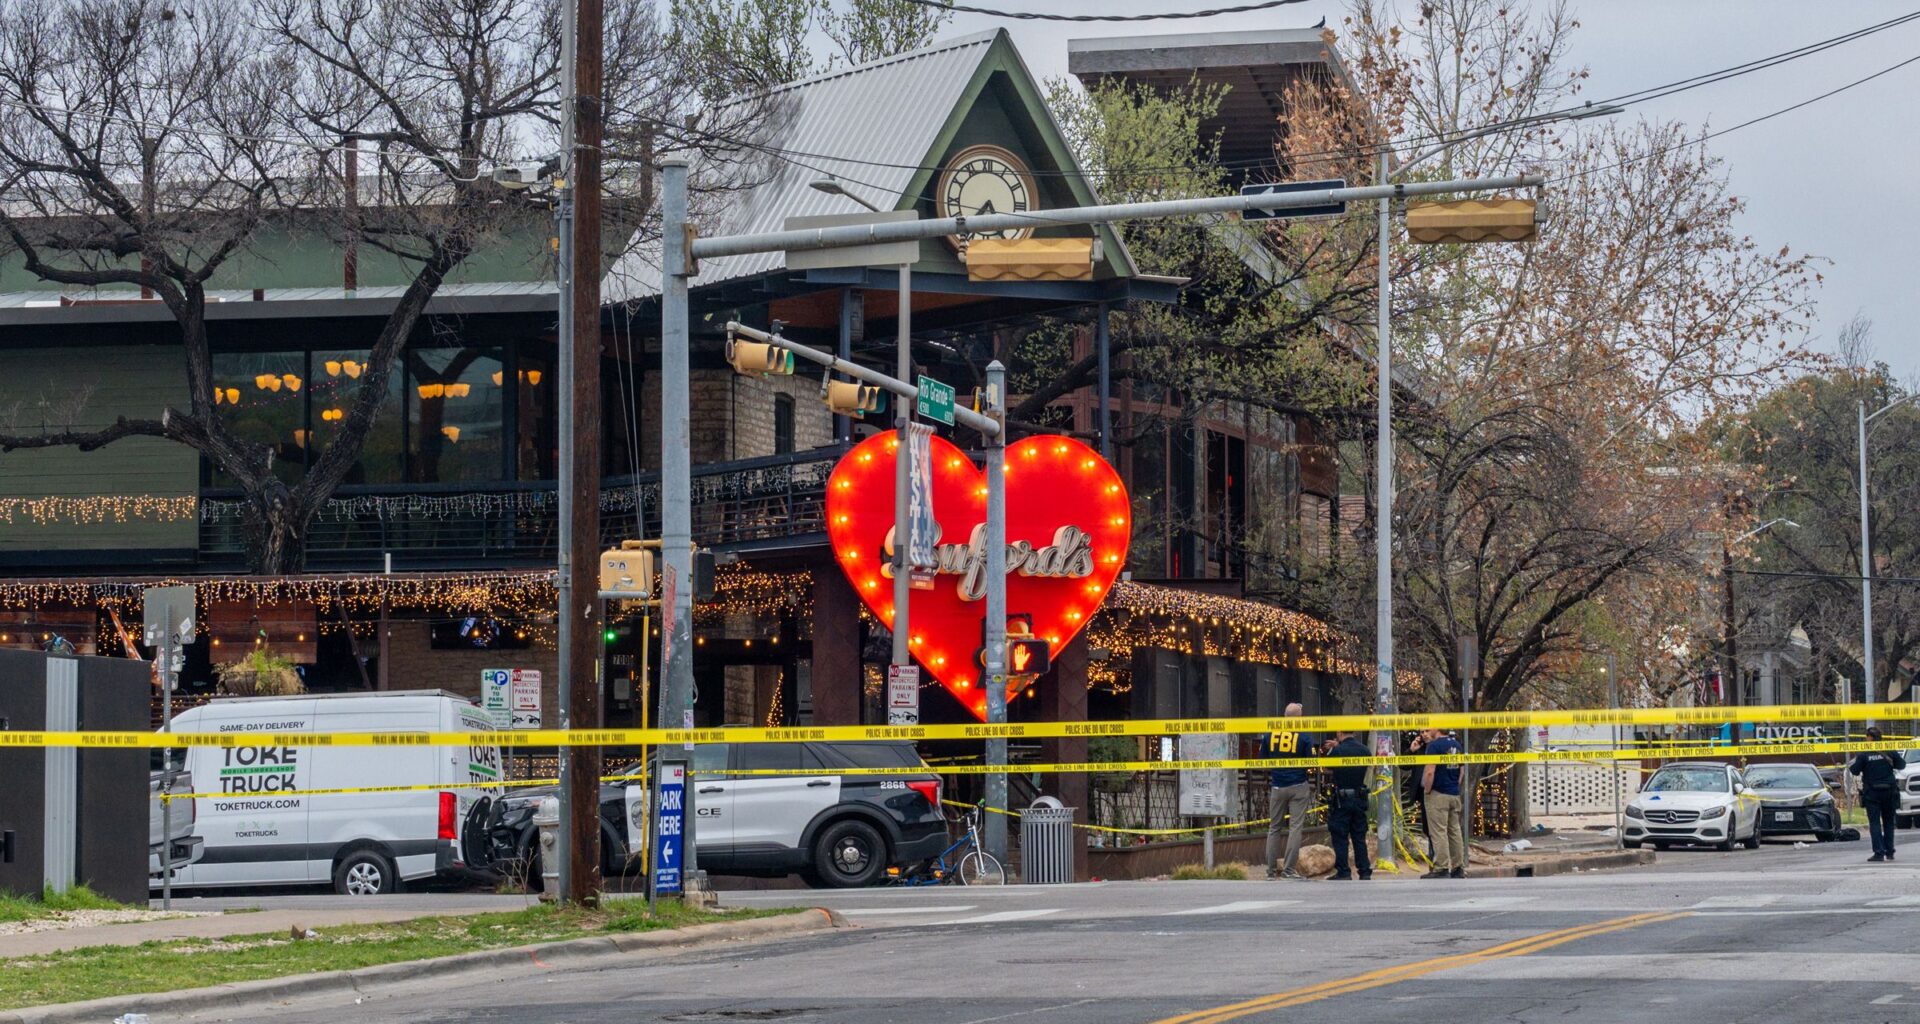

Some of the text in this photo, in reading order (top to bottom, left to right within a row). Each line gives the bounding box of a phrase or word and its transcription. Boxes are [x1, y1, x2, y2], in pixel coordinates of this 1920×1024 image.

[920, 378, 929, 399] Rio
[930, 382, 948, 406] Grande
[513, 671, 521, 680] NO
[891, 668, 899, 676] NO
[497, 673, 505, 683] P
[220, 722, 305, 732] SAME-DAY DELIVERY
[965, 726, 1024, 736] POLICE LINE DO NOT CROSS
[1065, 724, 1124, 734] POLICE LINE DO NOT CROSS
[1165, 722, 1225, 732] POLICE LINE DO NOT CROSS
[765, 730, 824, 740] POLICE LINE DO NOT CROSS
[866, 728, 925, 737] POLICE LINE DO NOT CROSS
[1756, 724, 1822, 744] rivers
[1270, 732, 1299, 753] FBI
[221, 746, 297, 766] TOKE
[220, 774, 296, 793] TRUCK
[469, 772, 498, 796] TRUCK
[880, 781, 906, 789] 2868
[215, 800, 300, 811] TOKETRUCK.COM
